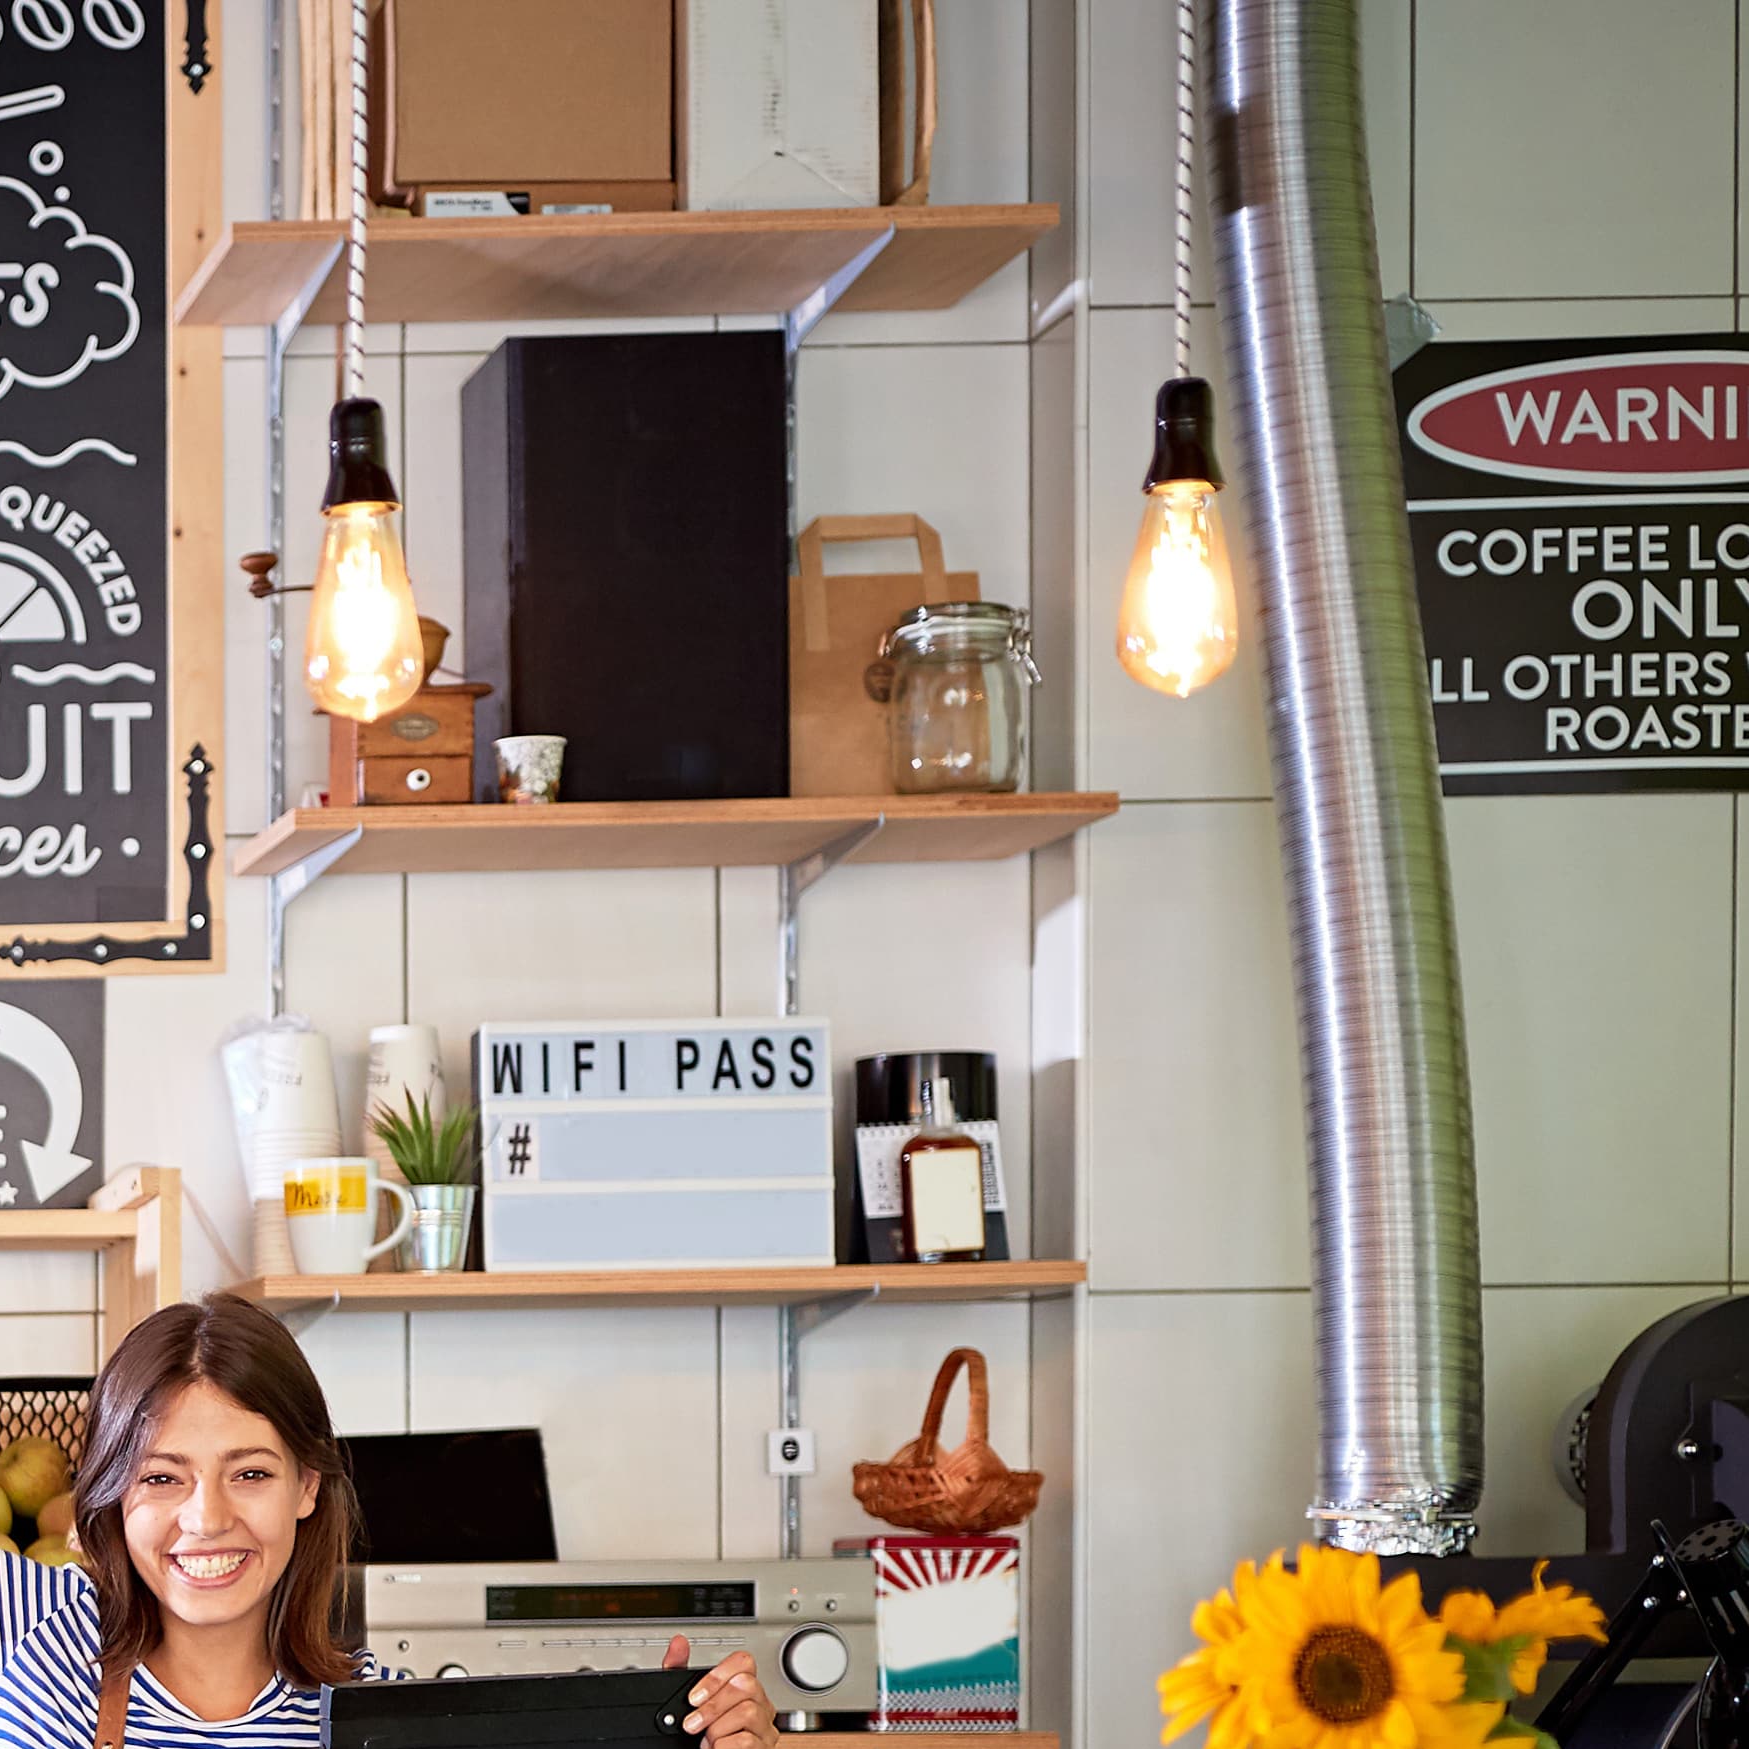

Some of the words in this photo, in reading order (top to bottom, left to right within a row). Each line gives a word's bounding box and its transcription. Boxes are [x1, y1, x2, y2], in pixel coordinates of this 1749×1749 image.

[1495, 384, 1749, 447] WARNI
[1437, 524, 1671, 578] COFFEE
[1571, 577, 1749, 642] ONL
[1431, 657, 1490, 703] LL
[1503, 650, 1732, 702] OTHERS
[492, 1039, 630, 1097] WIFI
[675, 1035, 817, 1092] PASS
[507, 1123, 532, 1176] #
